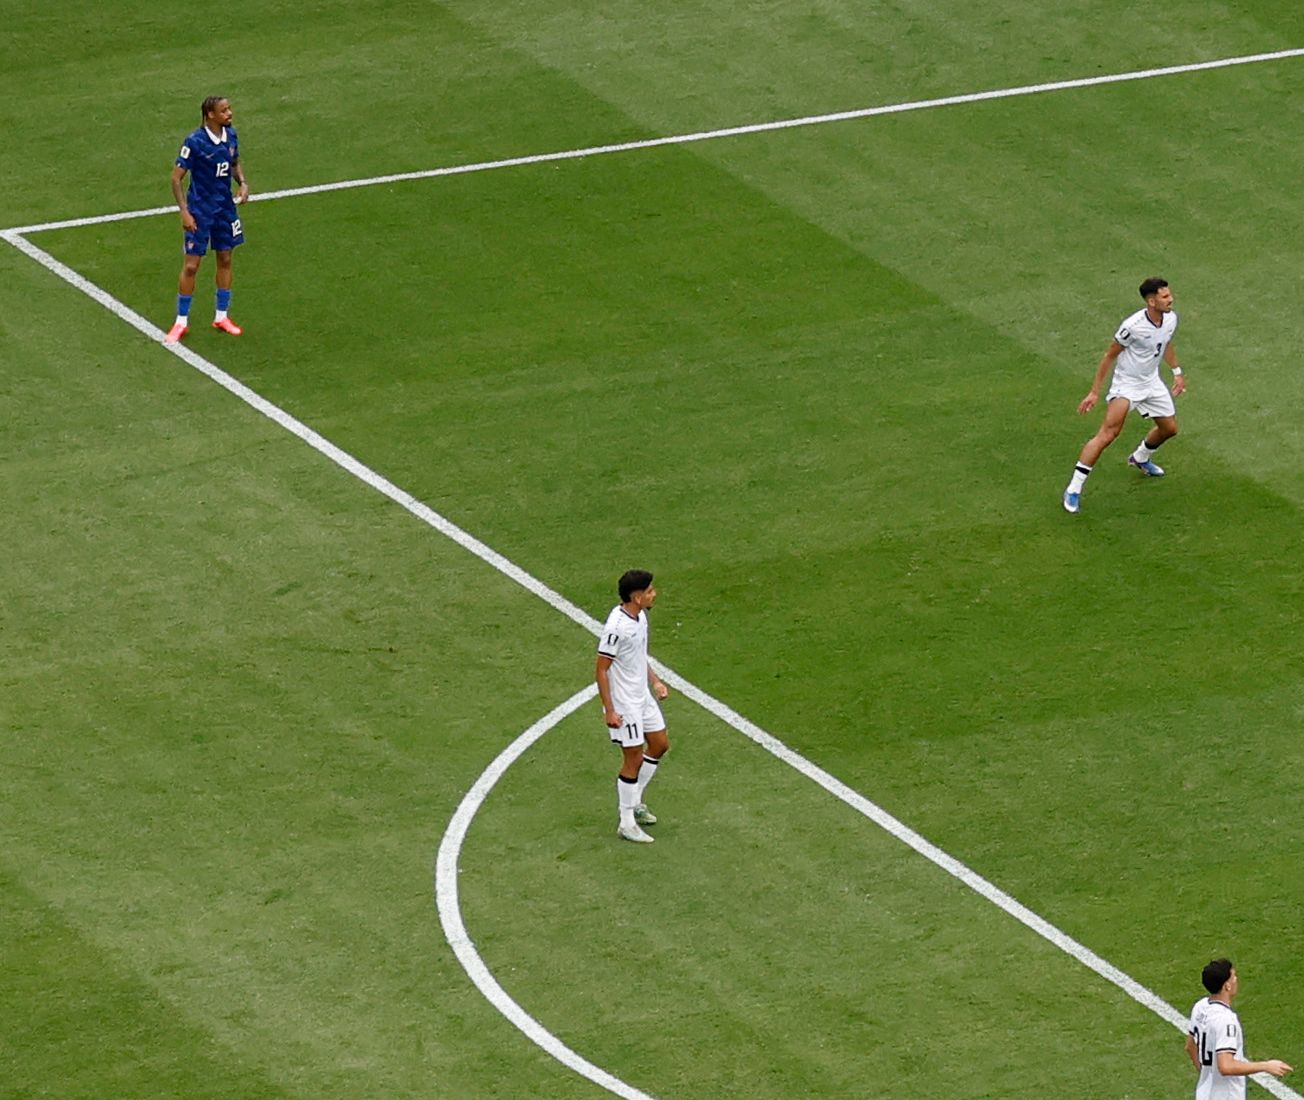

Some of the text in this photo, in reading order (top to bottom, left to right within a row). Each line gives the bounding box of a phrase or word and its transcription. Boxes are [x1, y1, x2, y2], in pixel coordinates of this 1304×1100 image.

[216, 161, 230, 177] 12
[231, 219, 242, 237] 12
[625, 723, 639, 739] 11
